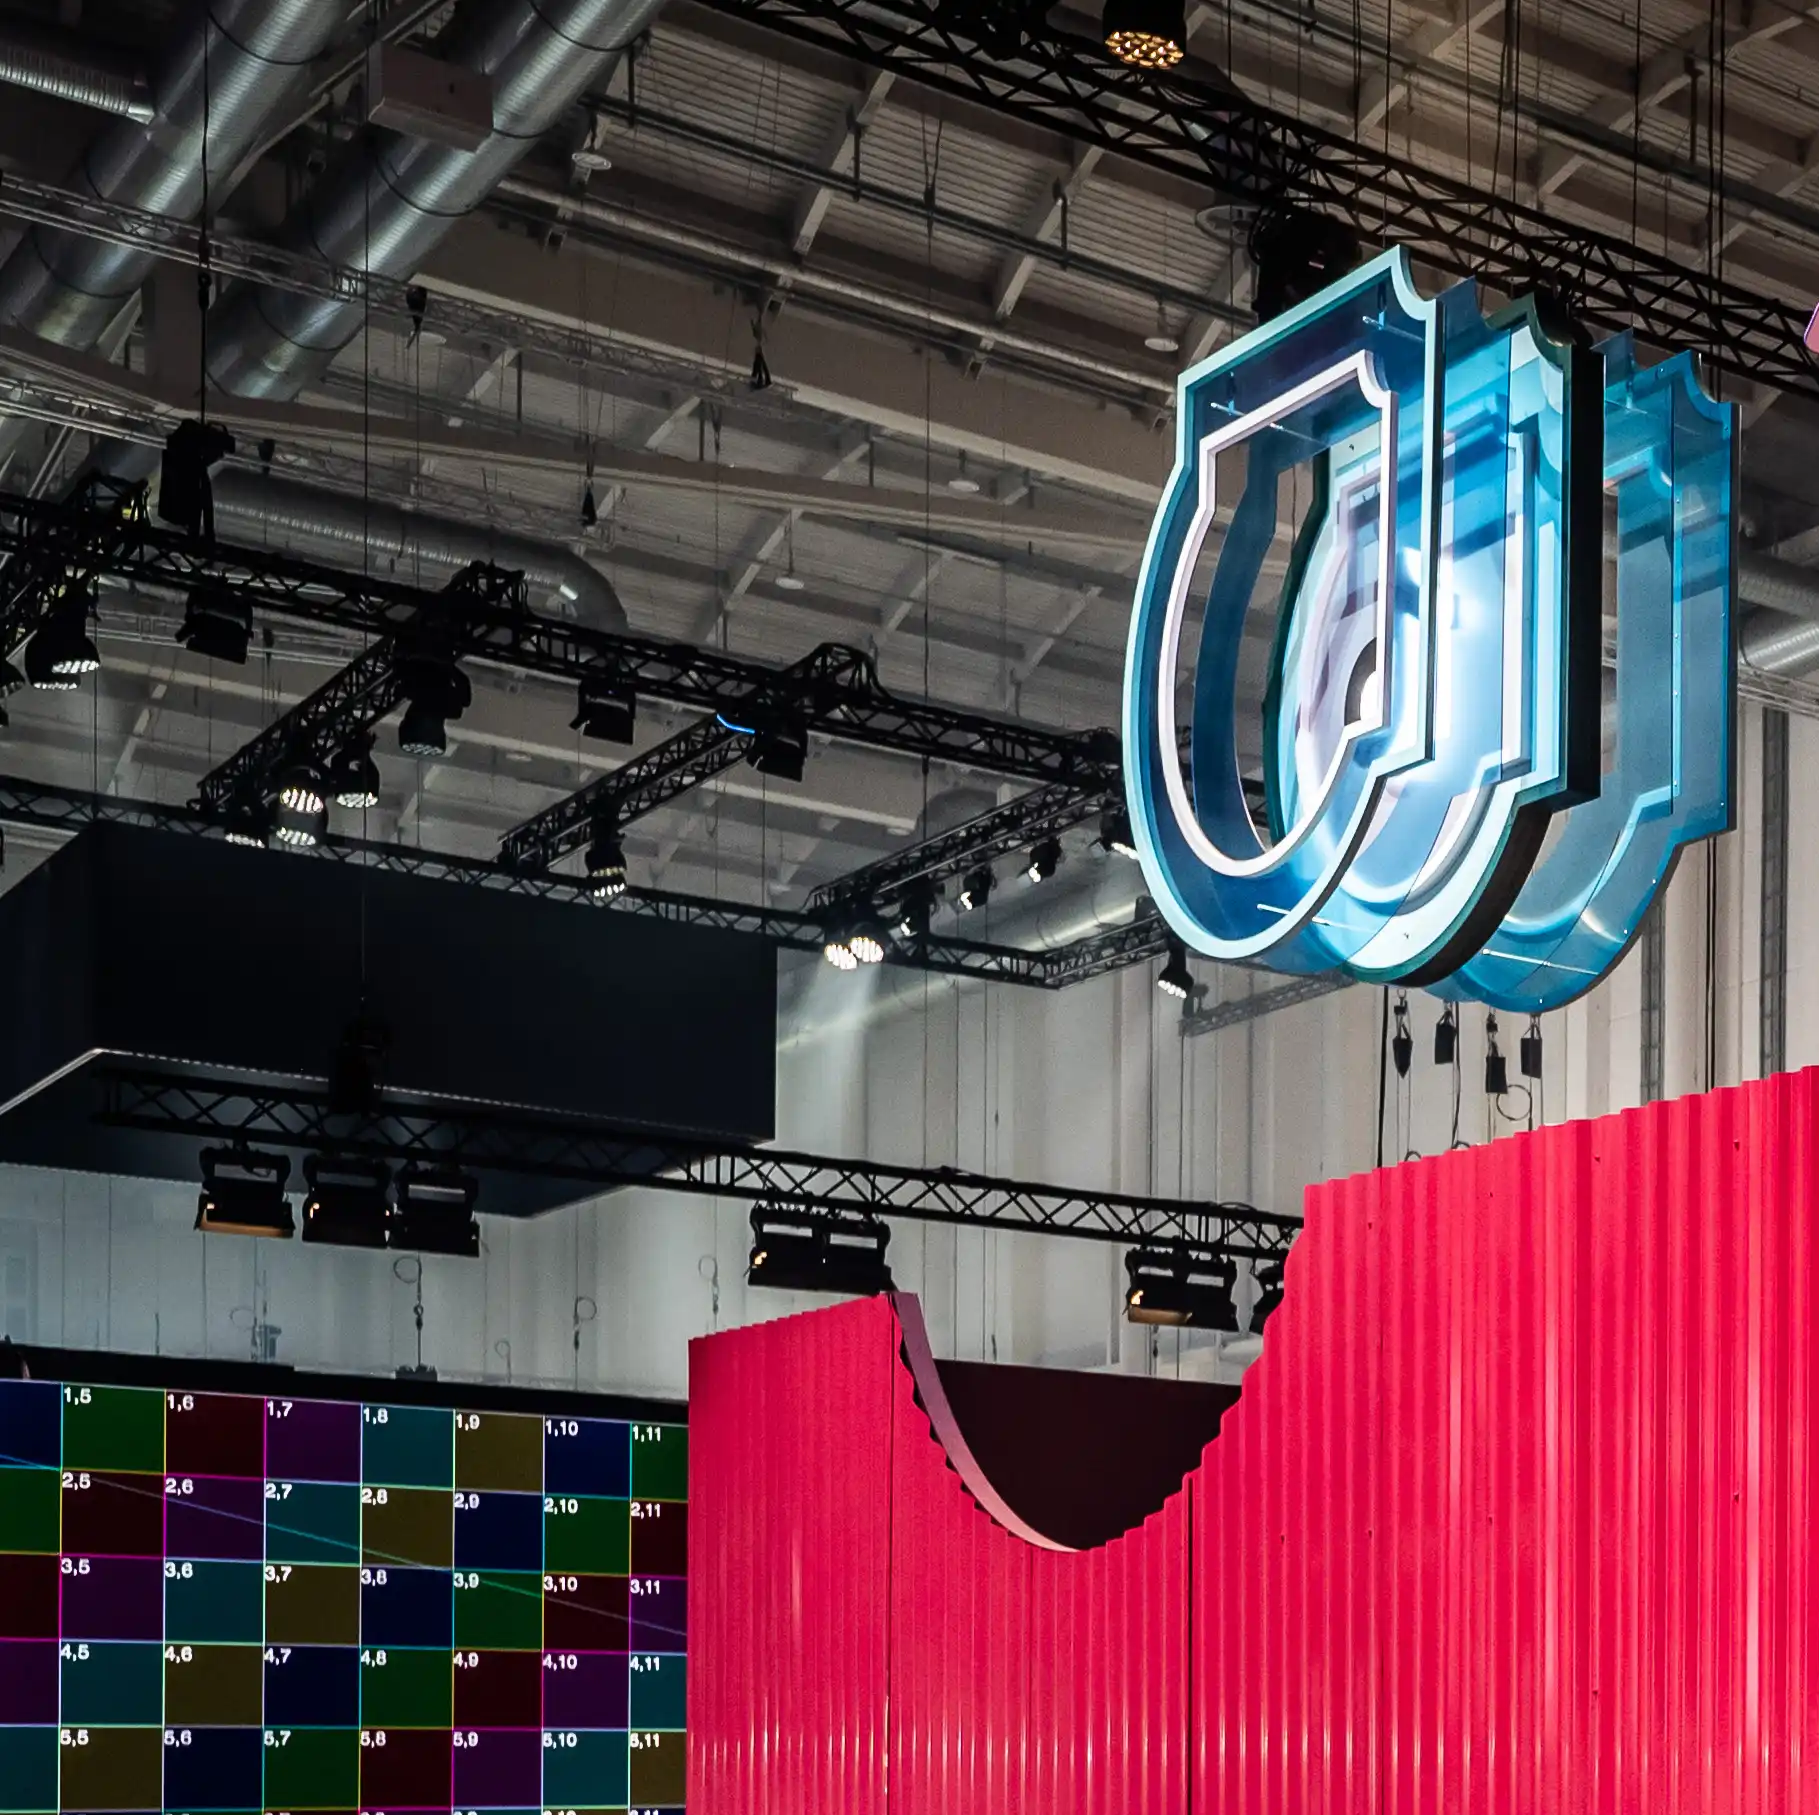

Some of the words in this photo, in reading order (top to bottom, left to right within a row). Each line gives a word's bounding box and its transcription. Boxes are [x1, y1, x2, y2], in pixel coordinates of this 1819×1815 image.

[63, 1388, 91, 1405] 1,5
[165, 1395, 193, 1412] 1,6
[266, 1401, 293, 1418] 1,7
[362, 1407, 388, 1424] 1,8
[454, 1413, 479, 1430] 1,9
[544, 1419, 578, 1436] 1,10
[632, 1425, 660, 1442] 1,11
[62, 1473, 90, 1491] 2,5
[164, 1479, 193, 1496] 2,6
[265, 1483, 292, 1500] 2,7
[361, 1488, 387, 1505] 2,8
[454, 1493, 479, 1510] 2,9
[544, 1497, 578, 1514] 2,10
[631, 1502, 660, 1519] 2,11
[62, 1559, 90, 1576] 3,5
[164, 1563, 193, 1580] 3,6
[265, 1566, 291, 1583] 3,7
[360, 1569, 387, 1586] 3,8
[454, 1572, 479, 1589] 3,9
[543, 1575, 577, 1592] 3,10
[631, 1578, 659, 1595] 3,11
[61, 1645, 89, 1661] 4,5
[163, 1647, 192, 1663] 4,6
[264, 1648, 291, 1665] 4,7
[360, 1650, 387, 1667] 4,8
[453, 1652, 478, 1669] 4,9
[542, 1653, 577, 1670] 4,10
[630, 1655, 659, 1672] 4,11
[60, 1730, 89, 1747] 5,5
[163, 1730, 191, 1747] 5,6
[264, 1731, 291, 1748] 5,7
[359, 1731, 386, 1748] 5,8
[453, 1731, 478, 1748] 5,9
[542, 1732, 577, 1749] 5,10
[629, 1732, 659, 1749] 5,11
